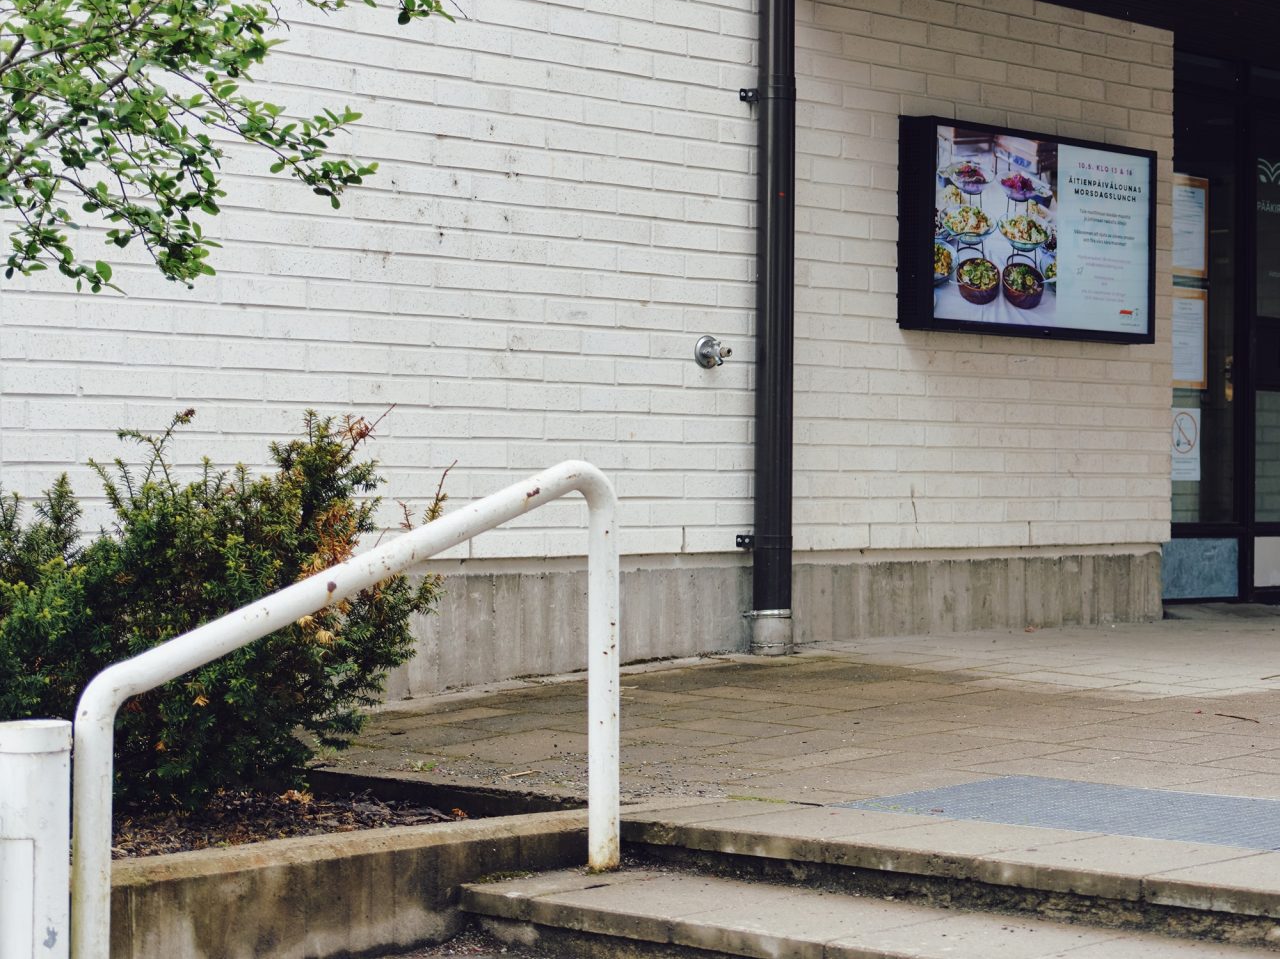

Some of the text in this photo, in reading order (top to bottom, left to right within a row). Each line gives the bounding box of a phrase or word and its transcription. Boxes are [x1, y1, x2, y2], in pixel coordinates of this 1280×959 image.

[1096, 165, 1109, 173] KLO
[1068, 175, 1142, 194] ÄITIENPÄIVÄLOUNAS
[1074, 188, 1137, 203] MORSDAGSLUNCH
